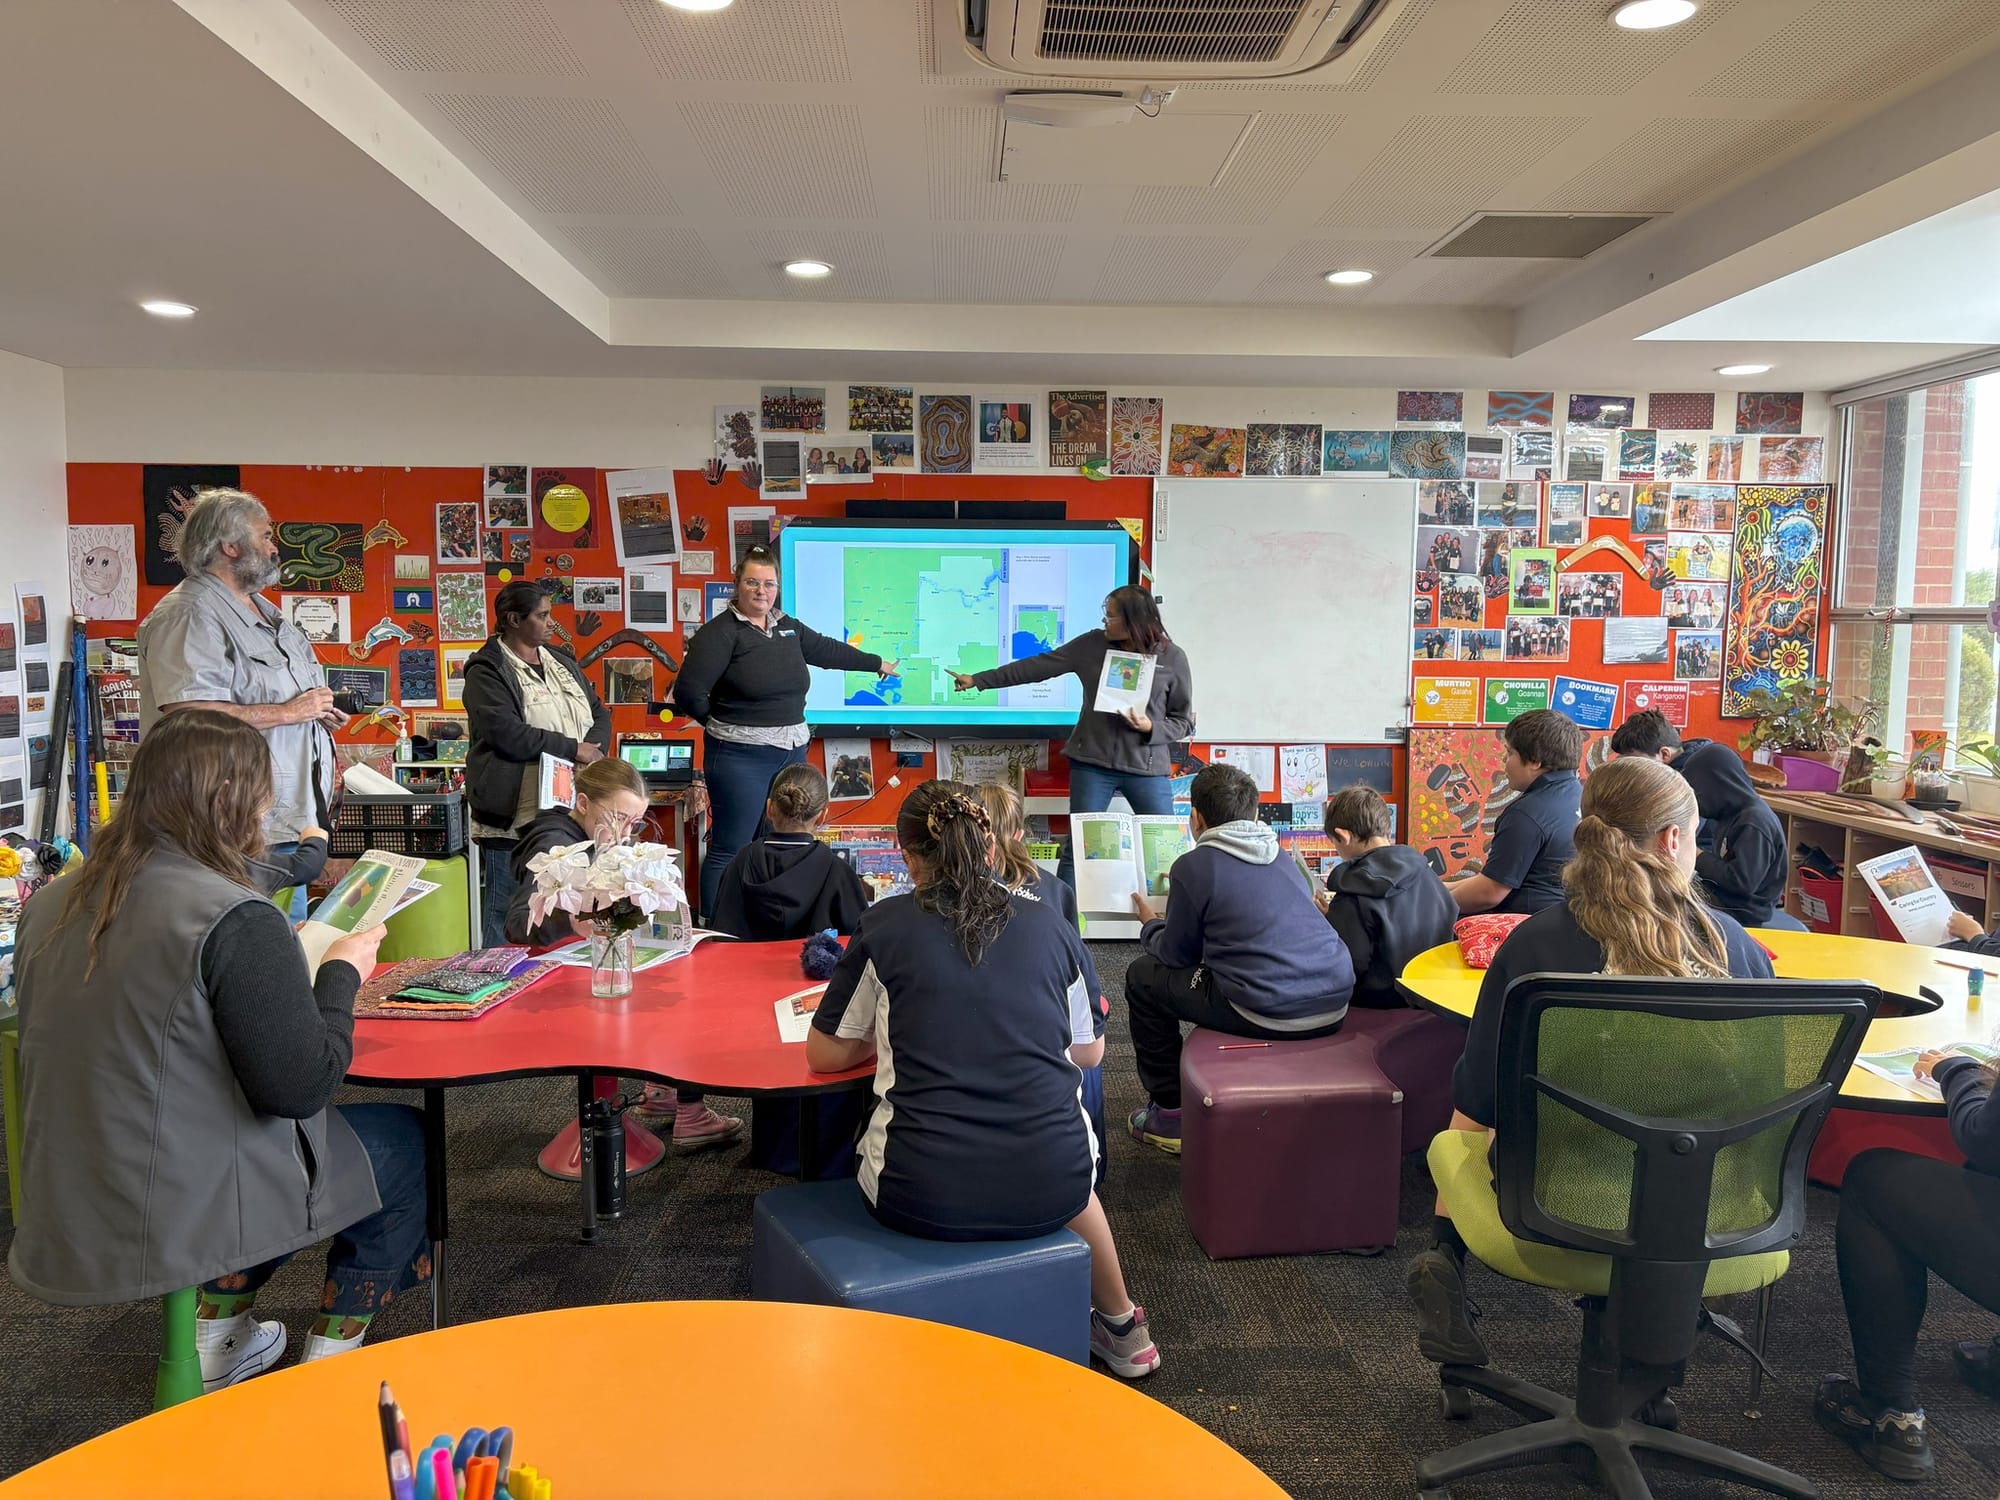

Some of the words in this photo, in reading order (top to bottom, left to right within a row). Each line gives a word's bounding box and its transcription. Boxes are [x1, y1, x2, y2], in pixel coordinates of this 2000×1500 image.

[1051, 393, 1066, 401] The
[1066, 392, 1105, 401] Advertiser
[1051, 442, 1067, 454] THE
[1069, 442, 1097, 454] DREAM
[1051, 454, 1074, 466] LIVES
[1076, 454, 1087, 466] ON
[1435, 679, 1471, 687] MURTHO
[1503, 681, 1546, 689] CHOWILLA
[1568, 681, 1617, 695] BOOKMARK
[1641, 684, 1687, 692] CALPERUM
[1517, 689, 1545, 698] Goannas
[1652, 693, 1685, 701] Kangaroos
[1292, 811, 1319, 820] ODY'S
